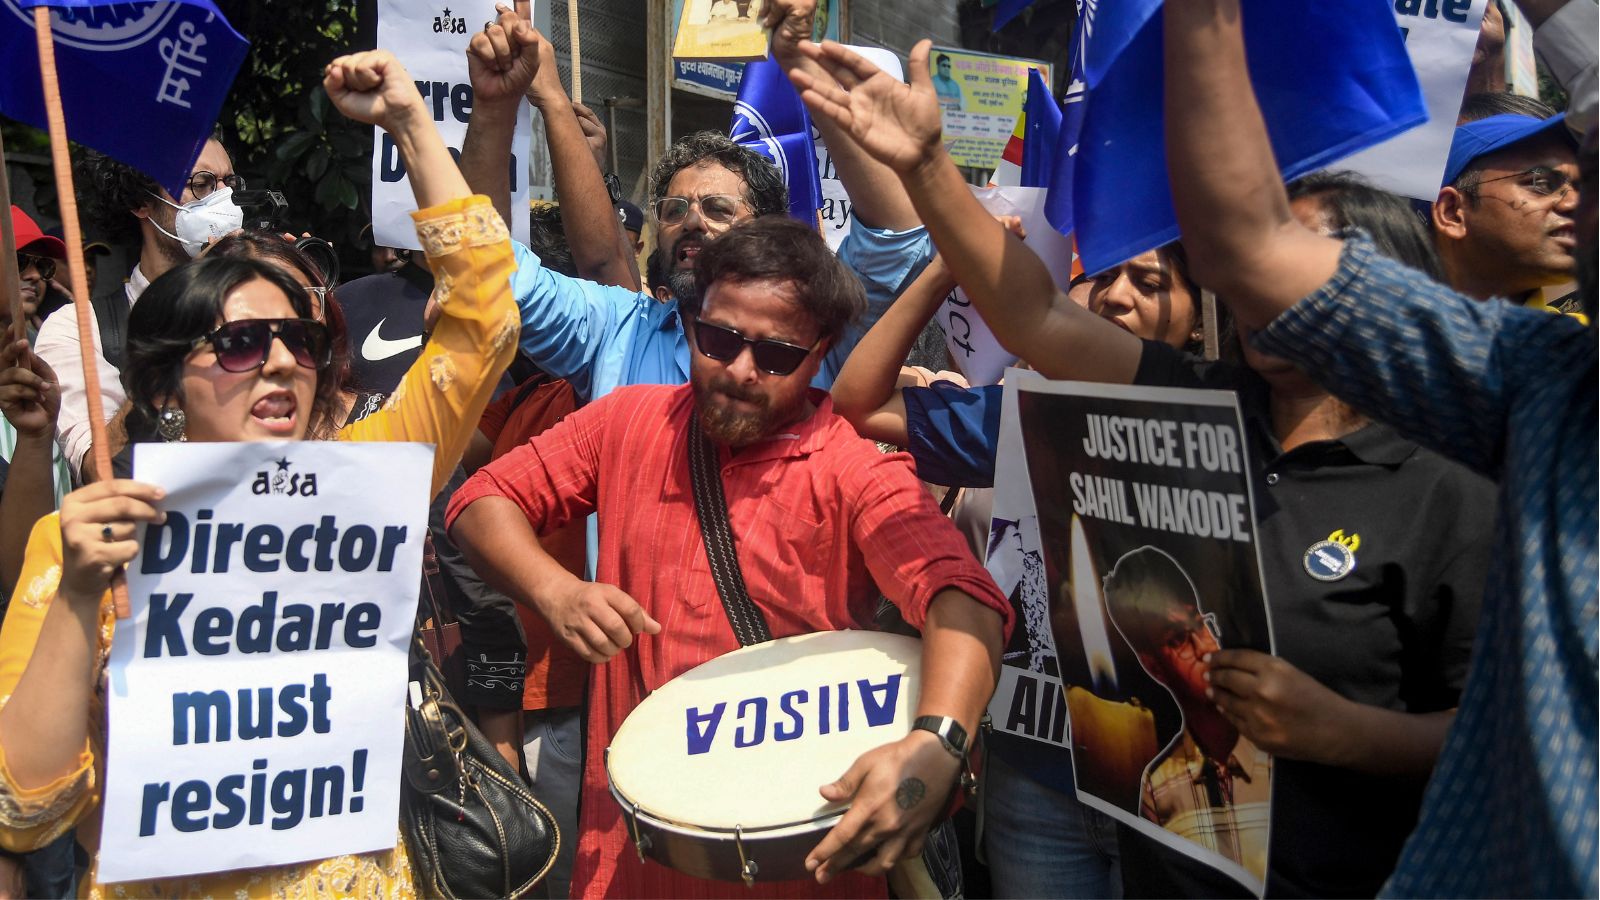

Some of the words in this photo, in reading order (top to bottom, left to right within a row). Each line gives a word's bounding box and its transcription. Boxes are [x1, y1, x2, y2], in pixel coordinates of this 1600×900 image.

[1082, 413, 1182, 468] JUSTICE
[1181, 422, 1241, 473] FOR
[140, 509, 408, 574] Director
[1069, 471, 1135, 526] SAHIL
[1132, 482, 1250, 542] WAKODE
[143, 590, 382, 659] Kedare
[172, 672, 332, 746] must
[685, 673, 902, 756] AIISCA
[1005, 674, 1070, 744] AII
[139, 748, 368, 838] resign!
